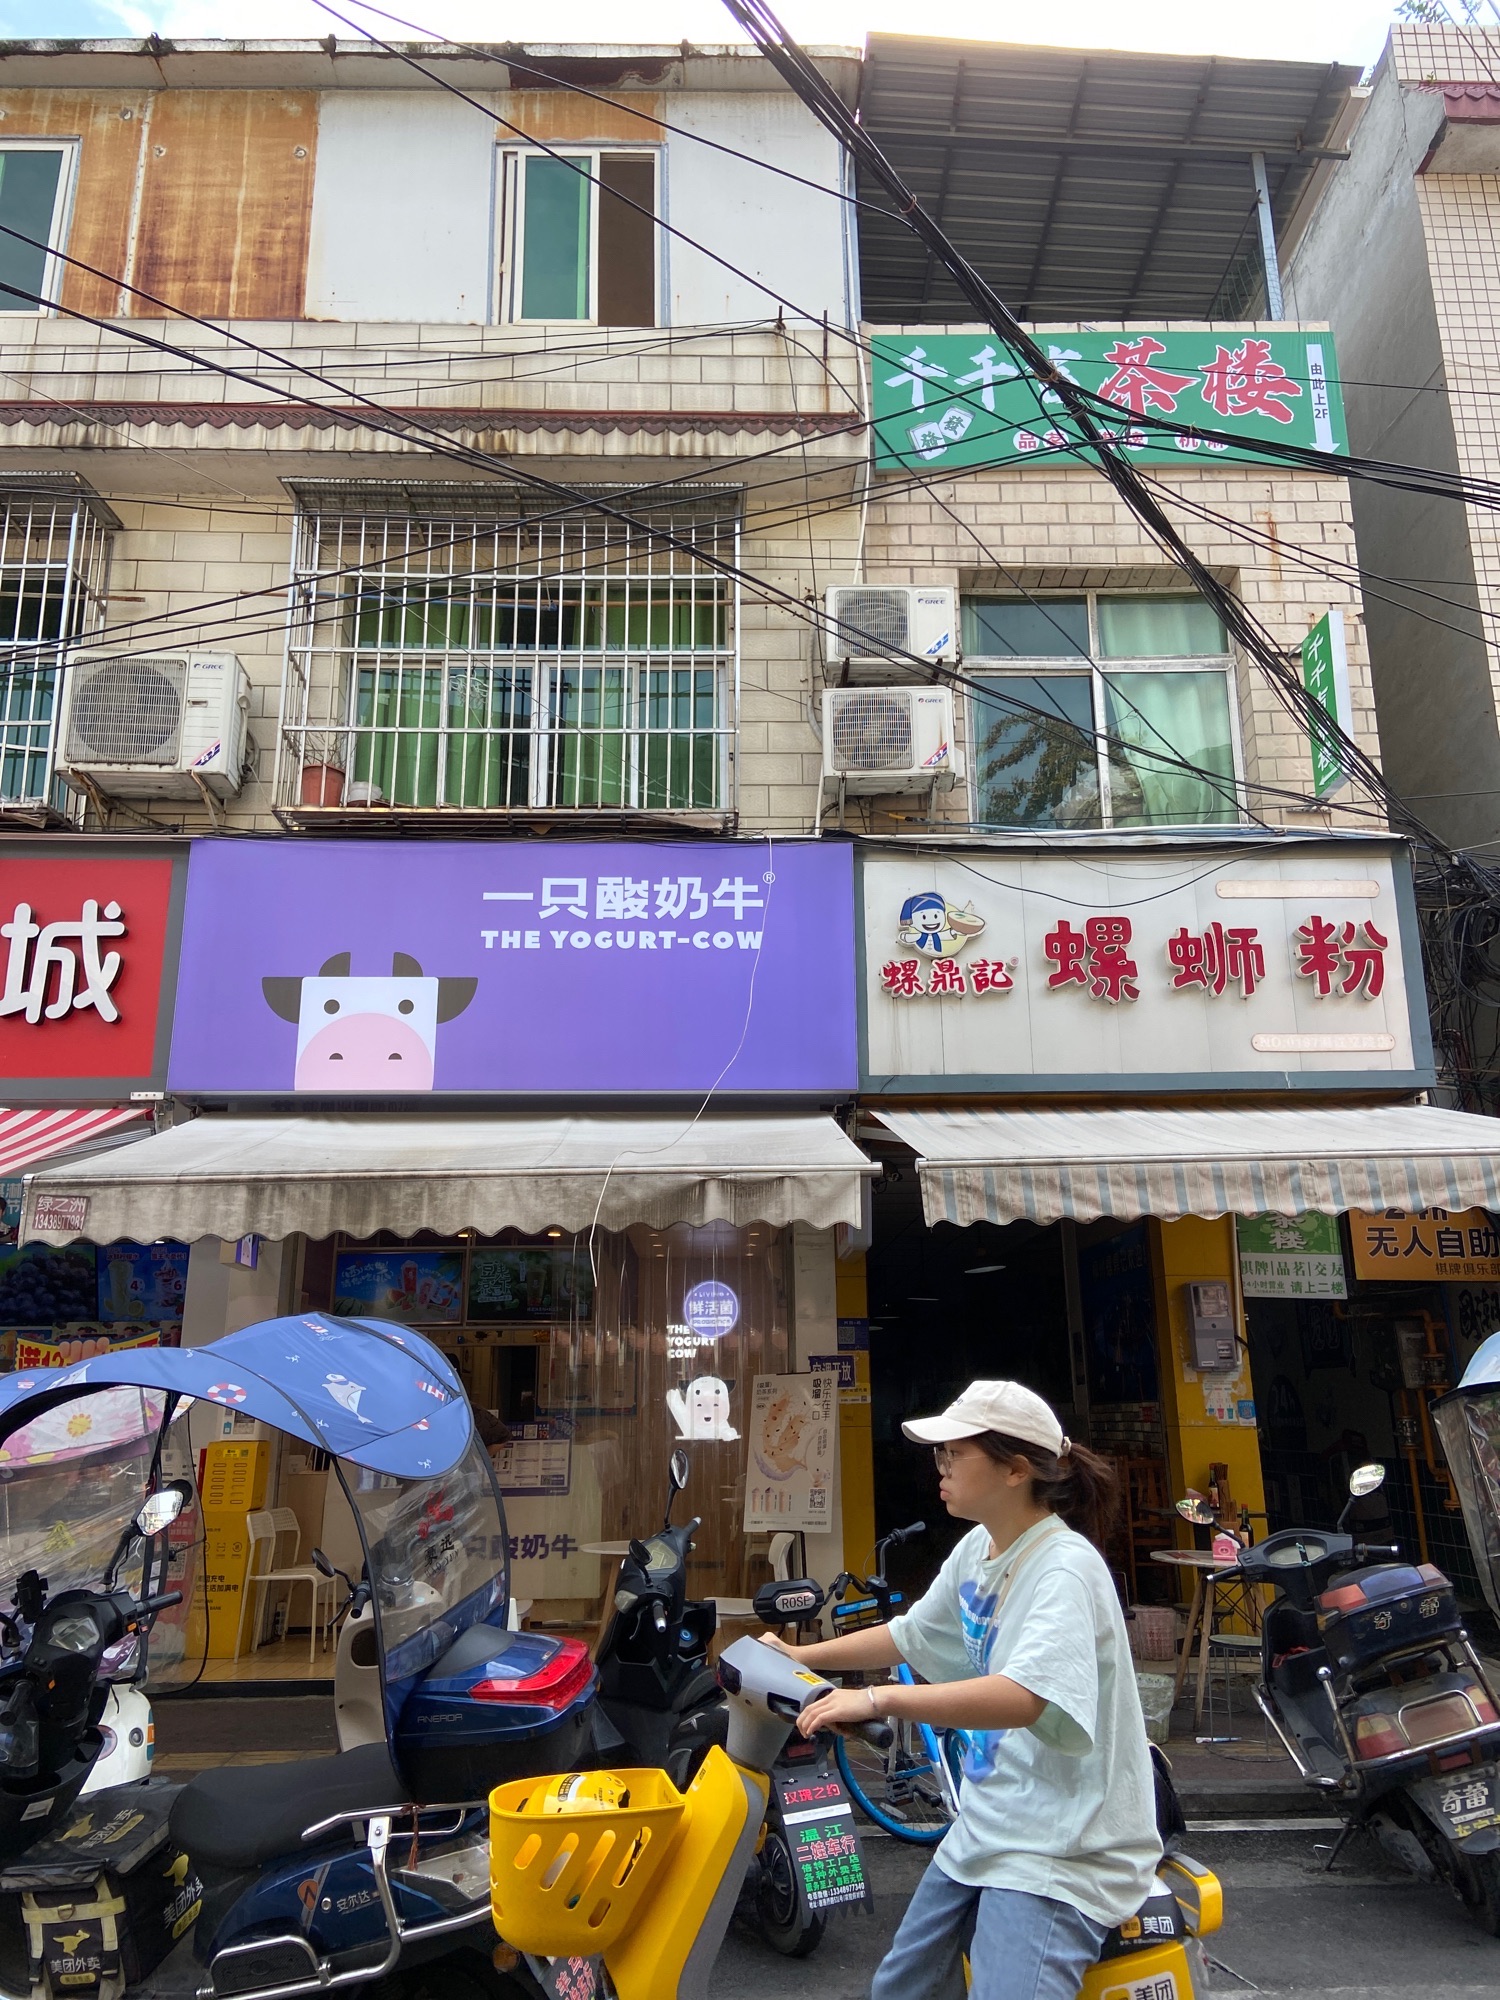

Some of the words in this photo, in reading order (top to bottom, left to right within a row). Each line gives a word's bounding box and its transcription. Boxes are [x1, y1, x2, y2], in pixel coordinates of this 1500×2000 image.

[1310, 361, 1330, 419] 由此上2F
[483, 877, 763, 920] 一只酸奶牛
[481, 931, 541, 949] THE
[549, 930, 763, 950] YOGURT-COW
[0, 899, 127, 1024] 城
[1043, 915, 1389, 1003] 螺蛳粉
[880, 957, 1015, 999] 螺鼎記
[37, 1196, 86, 1213] 绿之洲
[34, 1214, 84, 1231] 13438977981
[1366, 1225, 1500, 1258] 无人自助
[1291, 1281, 1344, 1294] 请上二楼
[689, 1299, 734, 1316] 鲜活菌
[666, 1324, 691, 1335] THE
[666, 1336, 716, 1347] YOGURT
[667, 1348, 697, 1359] COW
[822, 1378, 833, 1421] 快乐在手
[781, 1595, 810, 1610] ROSE
[783, 1783, 841, 1805] 玫瑰之约
[1441, 1782, 1489, 1814] 奇蕾
[800, 1824, 845, 1843] 温江
[797, 1835, 856, 1862] 二娃车行
[336, 1889, 370, 1912] 安尔达
[1143, 1916, 1175, 1935] 美团
[50, 1956, 101, 1974] 美团外卖
